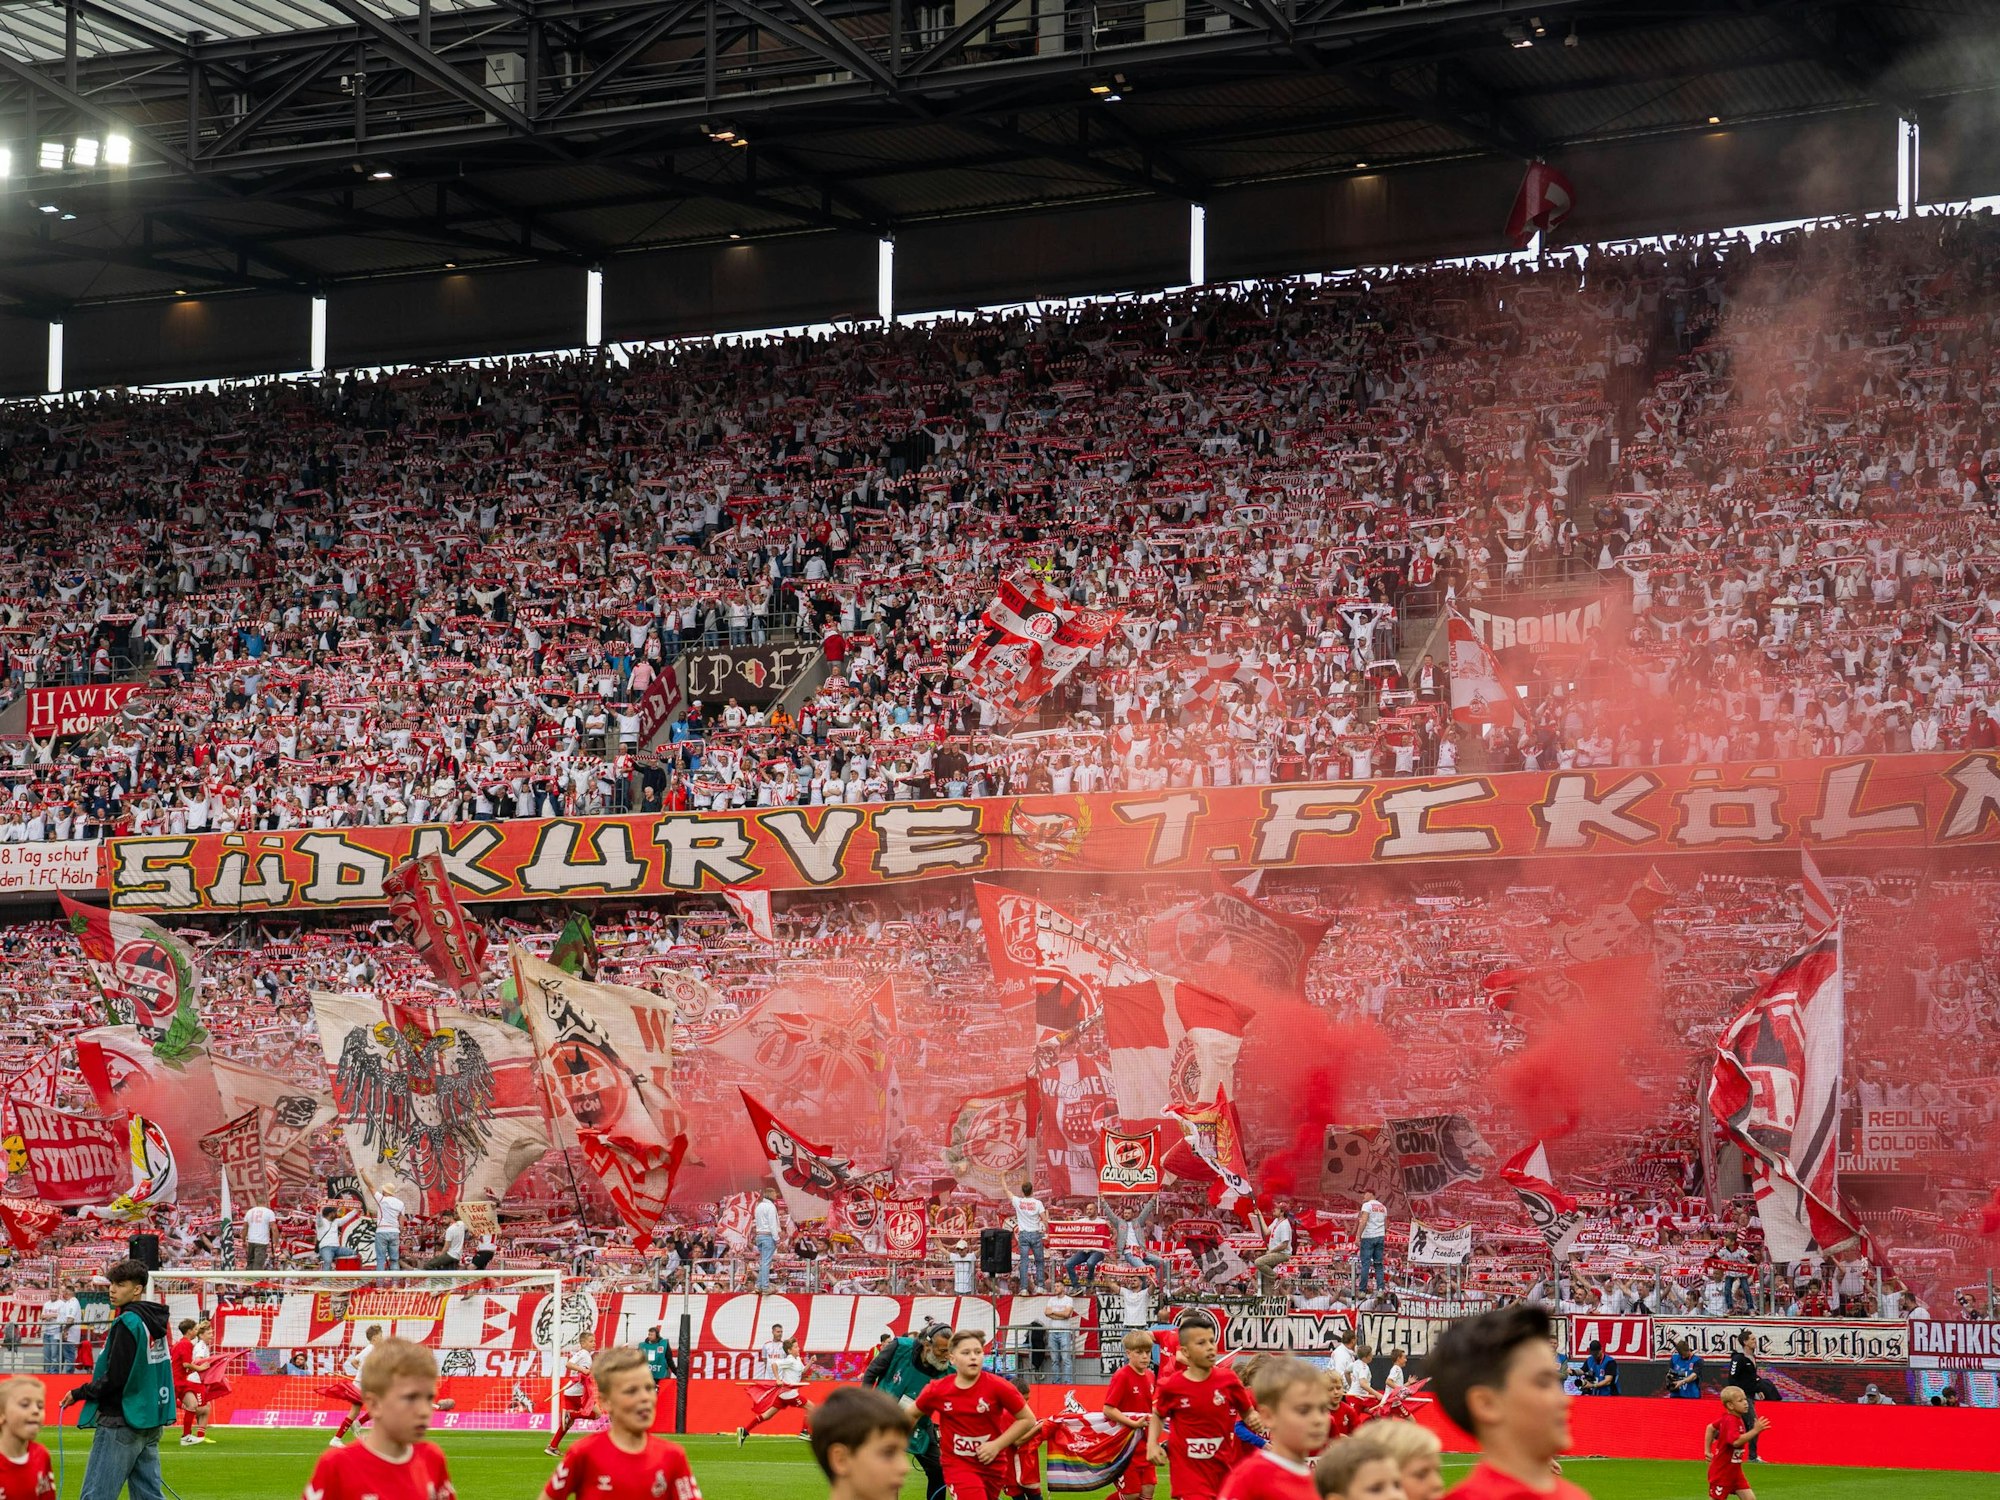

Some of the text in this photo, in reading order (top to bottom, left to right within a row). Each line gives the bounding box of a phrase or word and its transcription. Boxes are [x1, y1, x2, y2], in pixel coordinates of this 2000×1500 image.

[18, 848, 43, 867] Tag
[47, 845, 90, 862] schuf
[0, 873, 24, 887] den
[60, 864, 94, 884] Köln
[348, 1291, 447, 1318] STADIONVERBOT
[1225, 1314, 1355, 1350] COLONIACS
[1577, 1320, 1646, 1357] AJJ
[1784, 1325, 1902, 1364] Mythos
[1189, 1441, 1217, 1456] SAP
